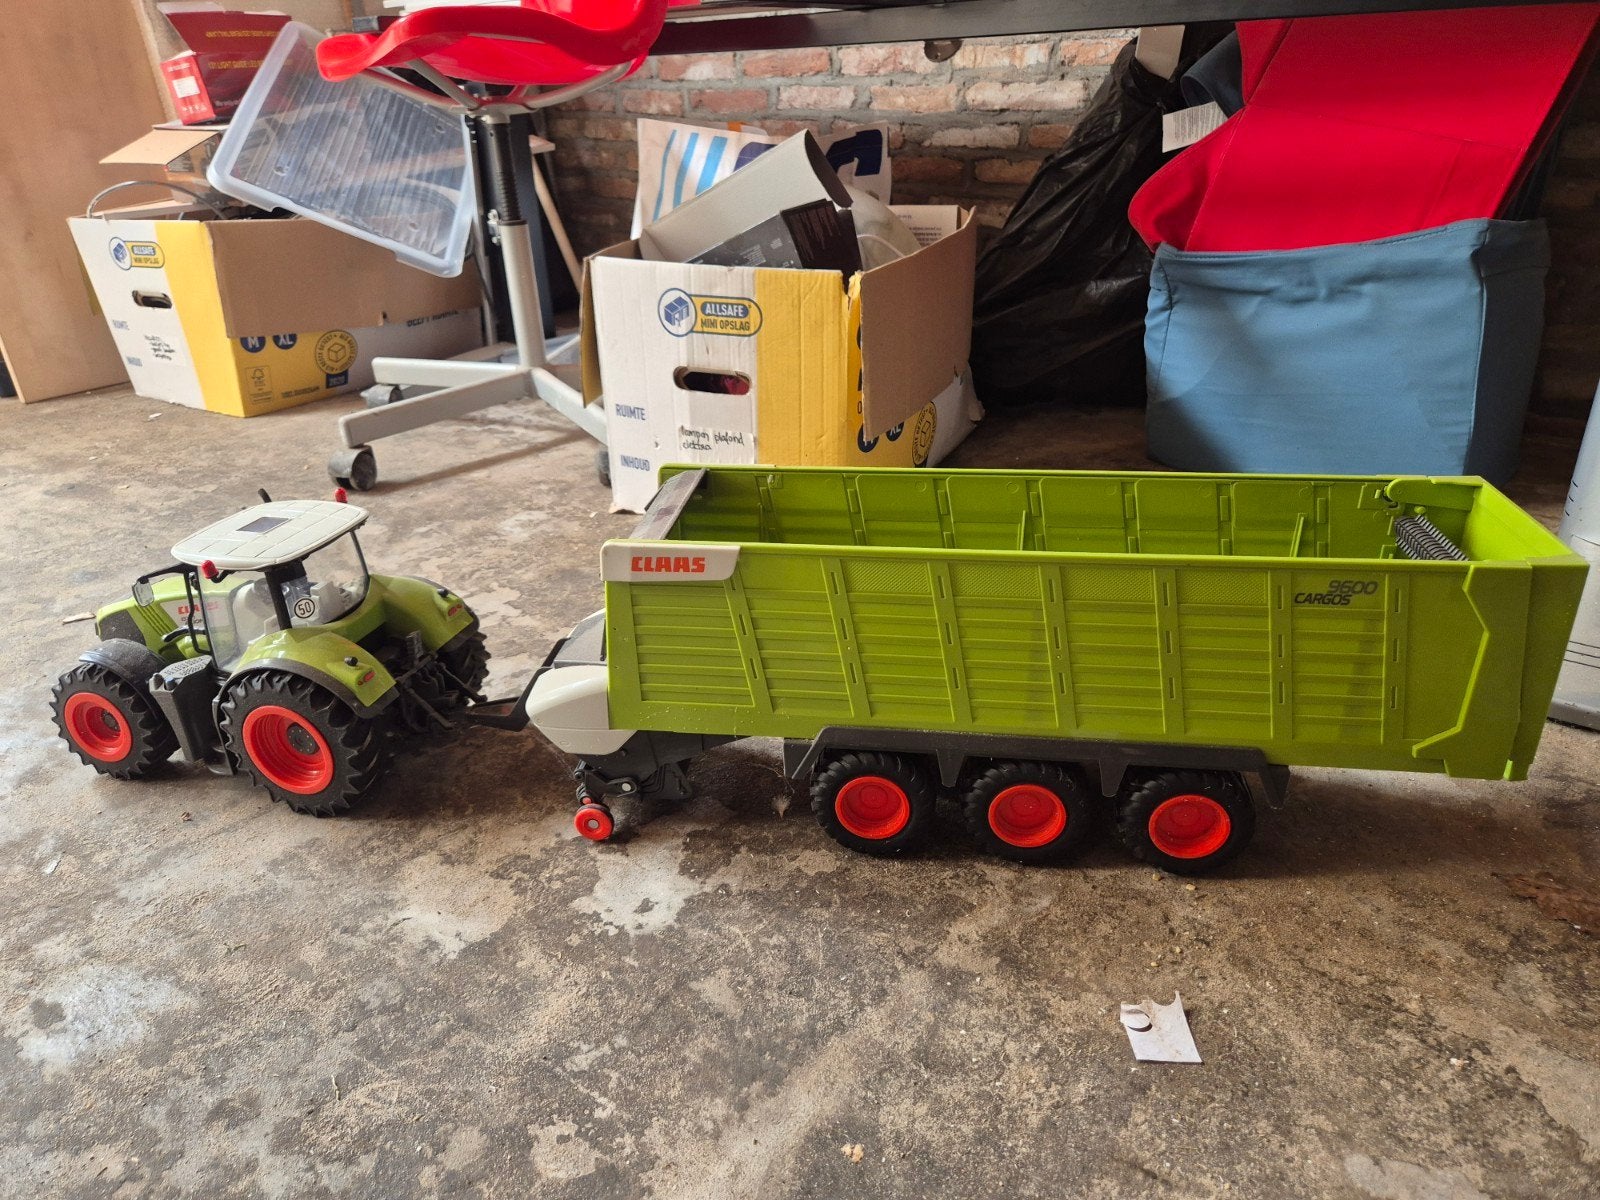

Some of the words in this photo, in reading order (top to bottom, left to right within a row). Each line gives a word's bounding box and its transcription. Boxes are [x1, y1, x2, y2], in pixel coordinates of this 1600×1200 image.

[705, 302, 744, 317] ALLSAFE
[700, 318, 718, 329] MINI
[719, 320, 750, 331] OPSLAG
[615, 403, 646, 421] RUIMTE
[714, 430, 745, 446] plafond
[620, 454, 651, 472] INHOUD
[631, 556, 705, 573] CLAAS
[1327, 579, 1378, 595] 9600
[1294, 592, 1353, 606] CARGOS
[298, 601, 312, 616] 50
